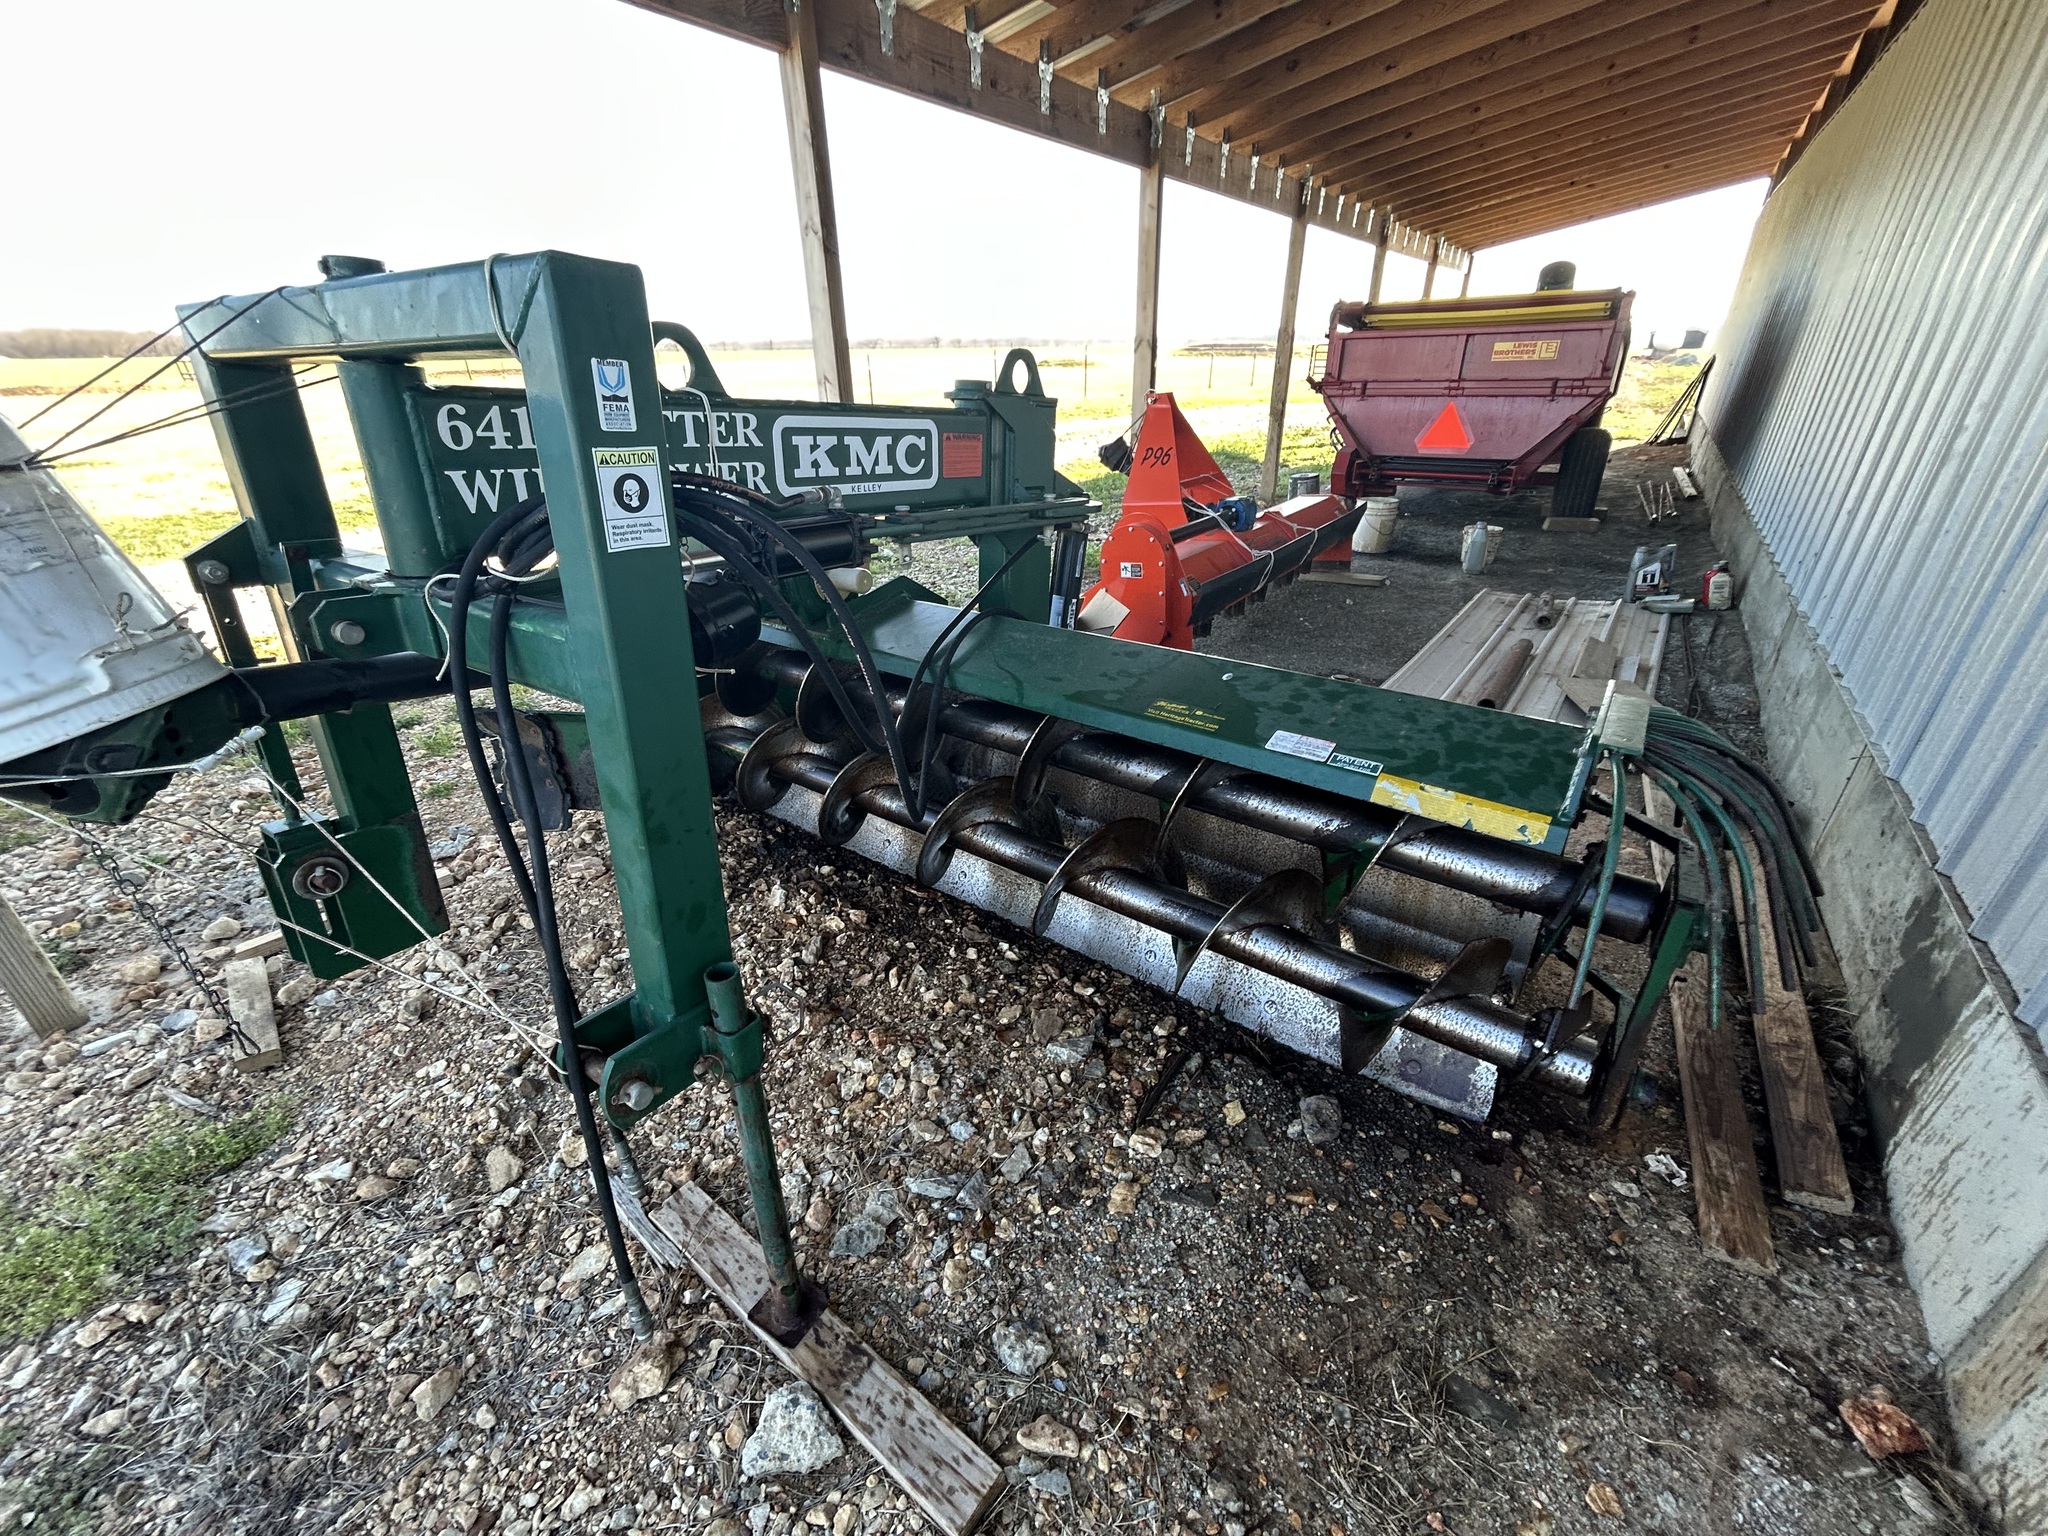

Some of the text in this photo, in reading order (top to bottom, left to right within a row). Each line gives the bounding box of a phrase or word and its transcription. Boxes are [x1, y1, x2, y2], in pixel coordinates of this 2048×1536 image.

[596, 360, 623, 368] MEMBER
[602, 403, 630, 413] FEMA
[609, 452, 655, 465] CAUTION
[792, 435, 926, 479] KMC
[1141, 446, 1174, 468] P96
[851, 484, 883, 493] KELLEY
[612, 529, 643, 537] Respiratory
[1336, 755, 1376, 769] PATENT
